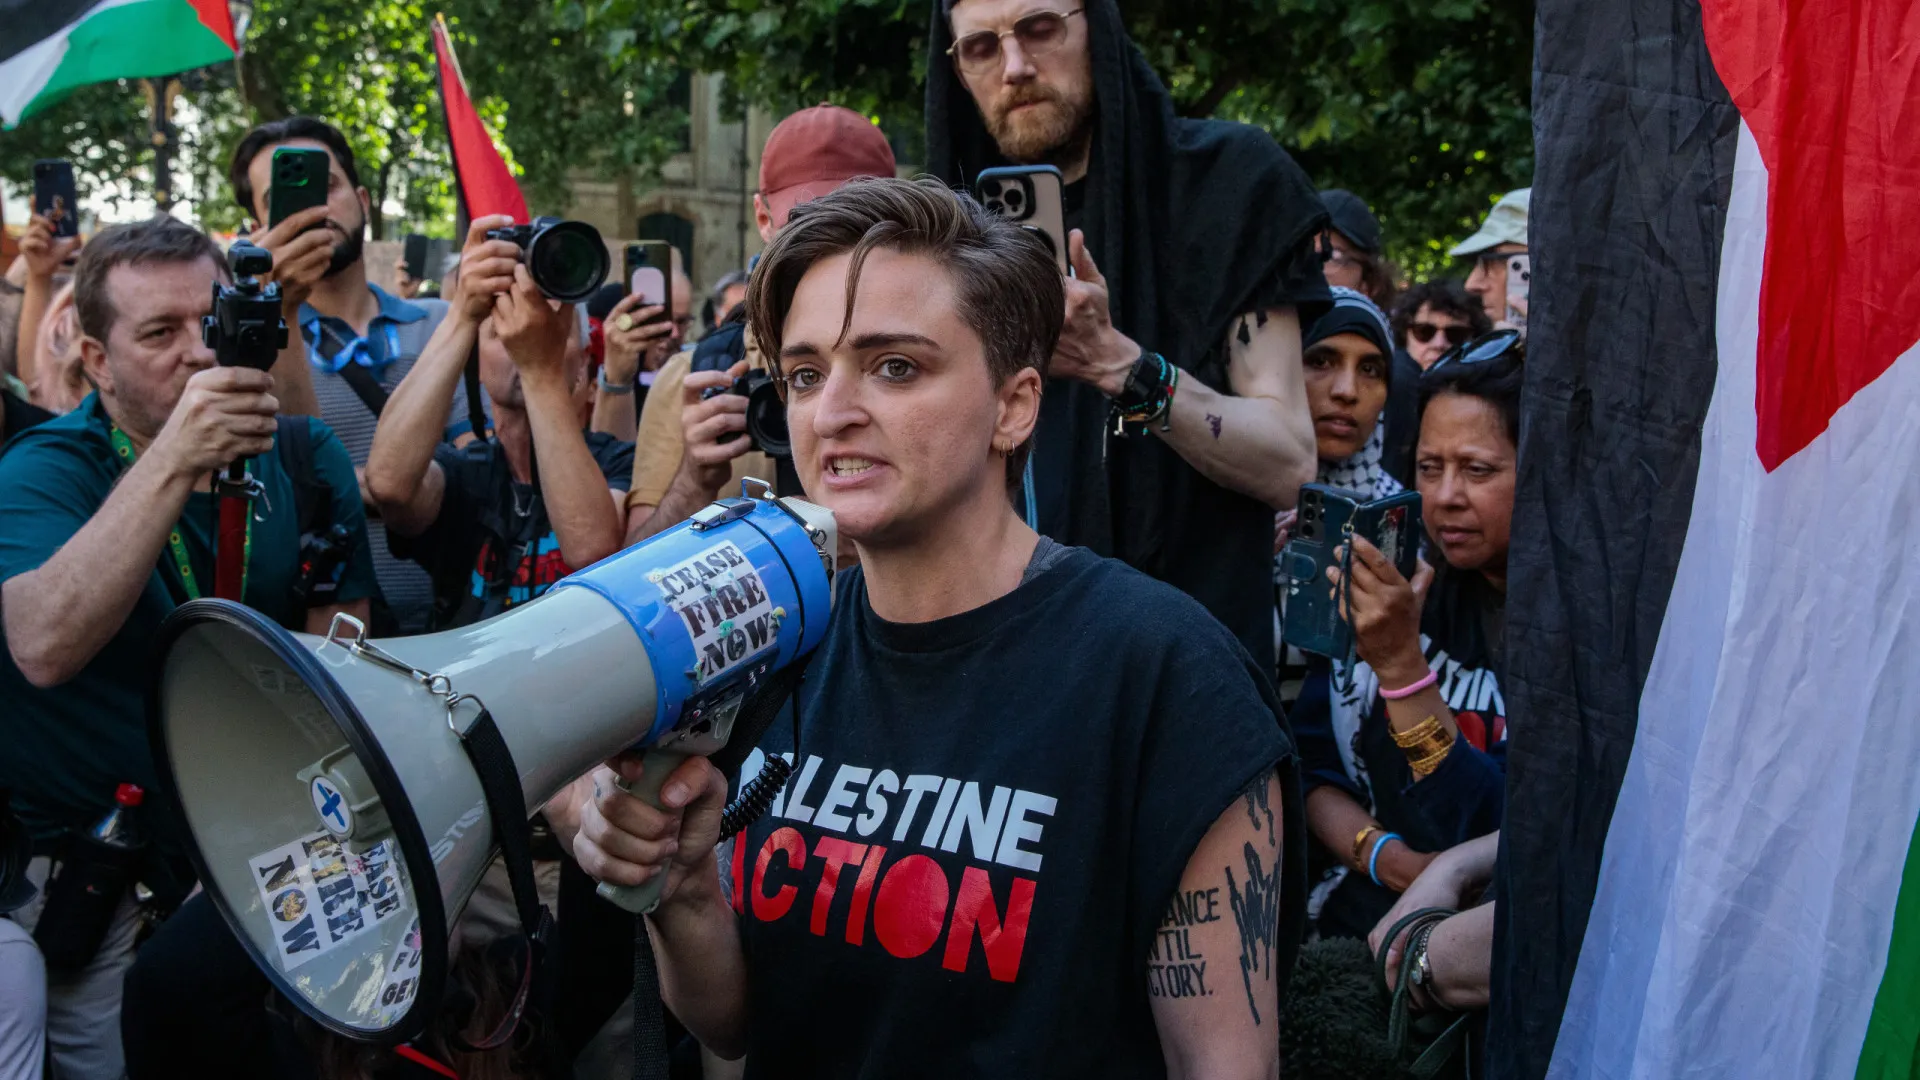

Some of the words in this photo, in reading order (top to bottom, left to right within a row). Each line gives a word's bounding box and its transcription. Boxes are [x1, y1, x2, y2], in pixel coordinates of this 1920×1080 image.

[662, 546, 744, 595] CEASE
[681, 572, 766, 638] FIRE
[703, 612, 770, 676] NOW
[260, 855, 320, 954] NOW
[360, 842, 400, 919] EASE
